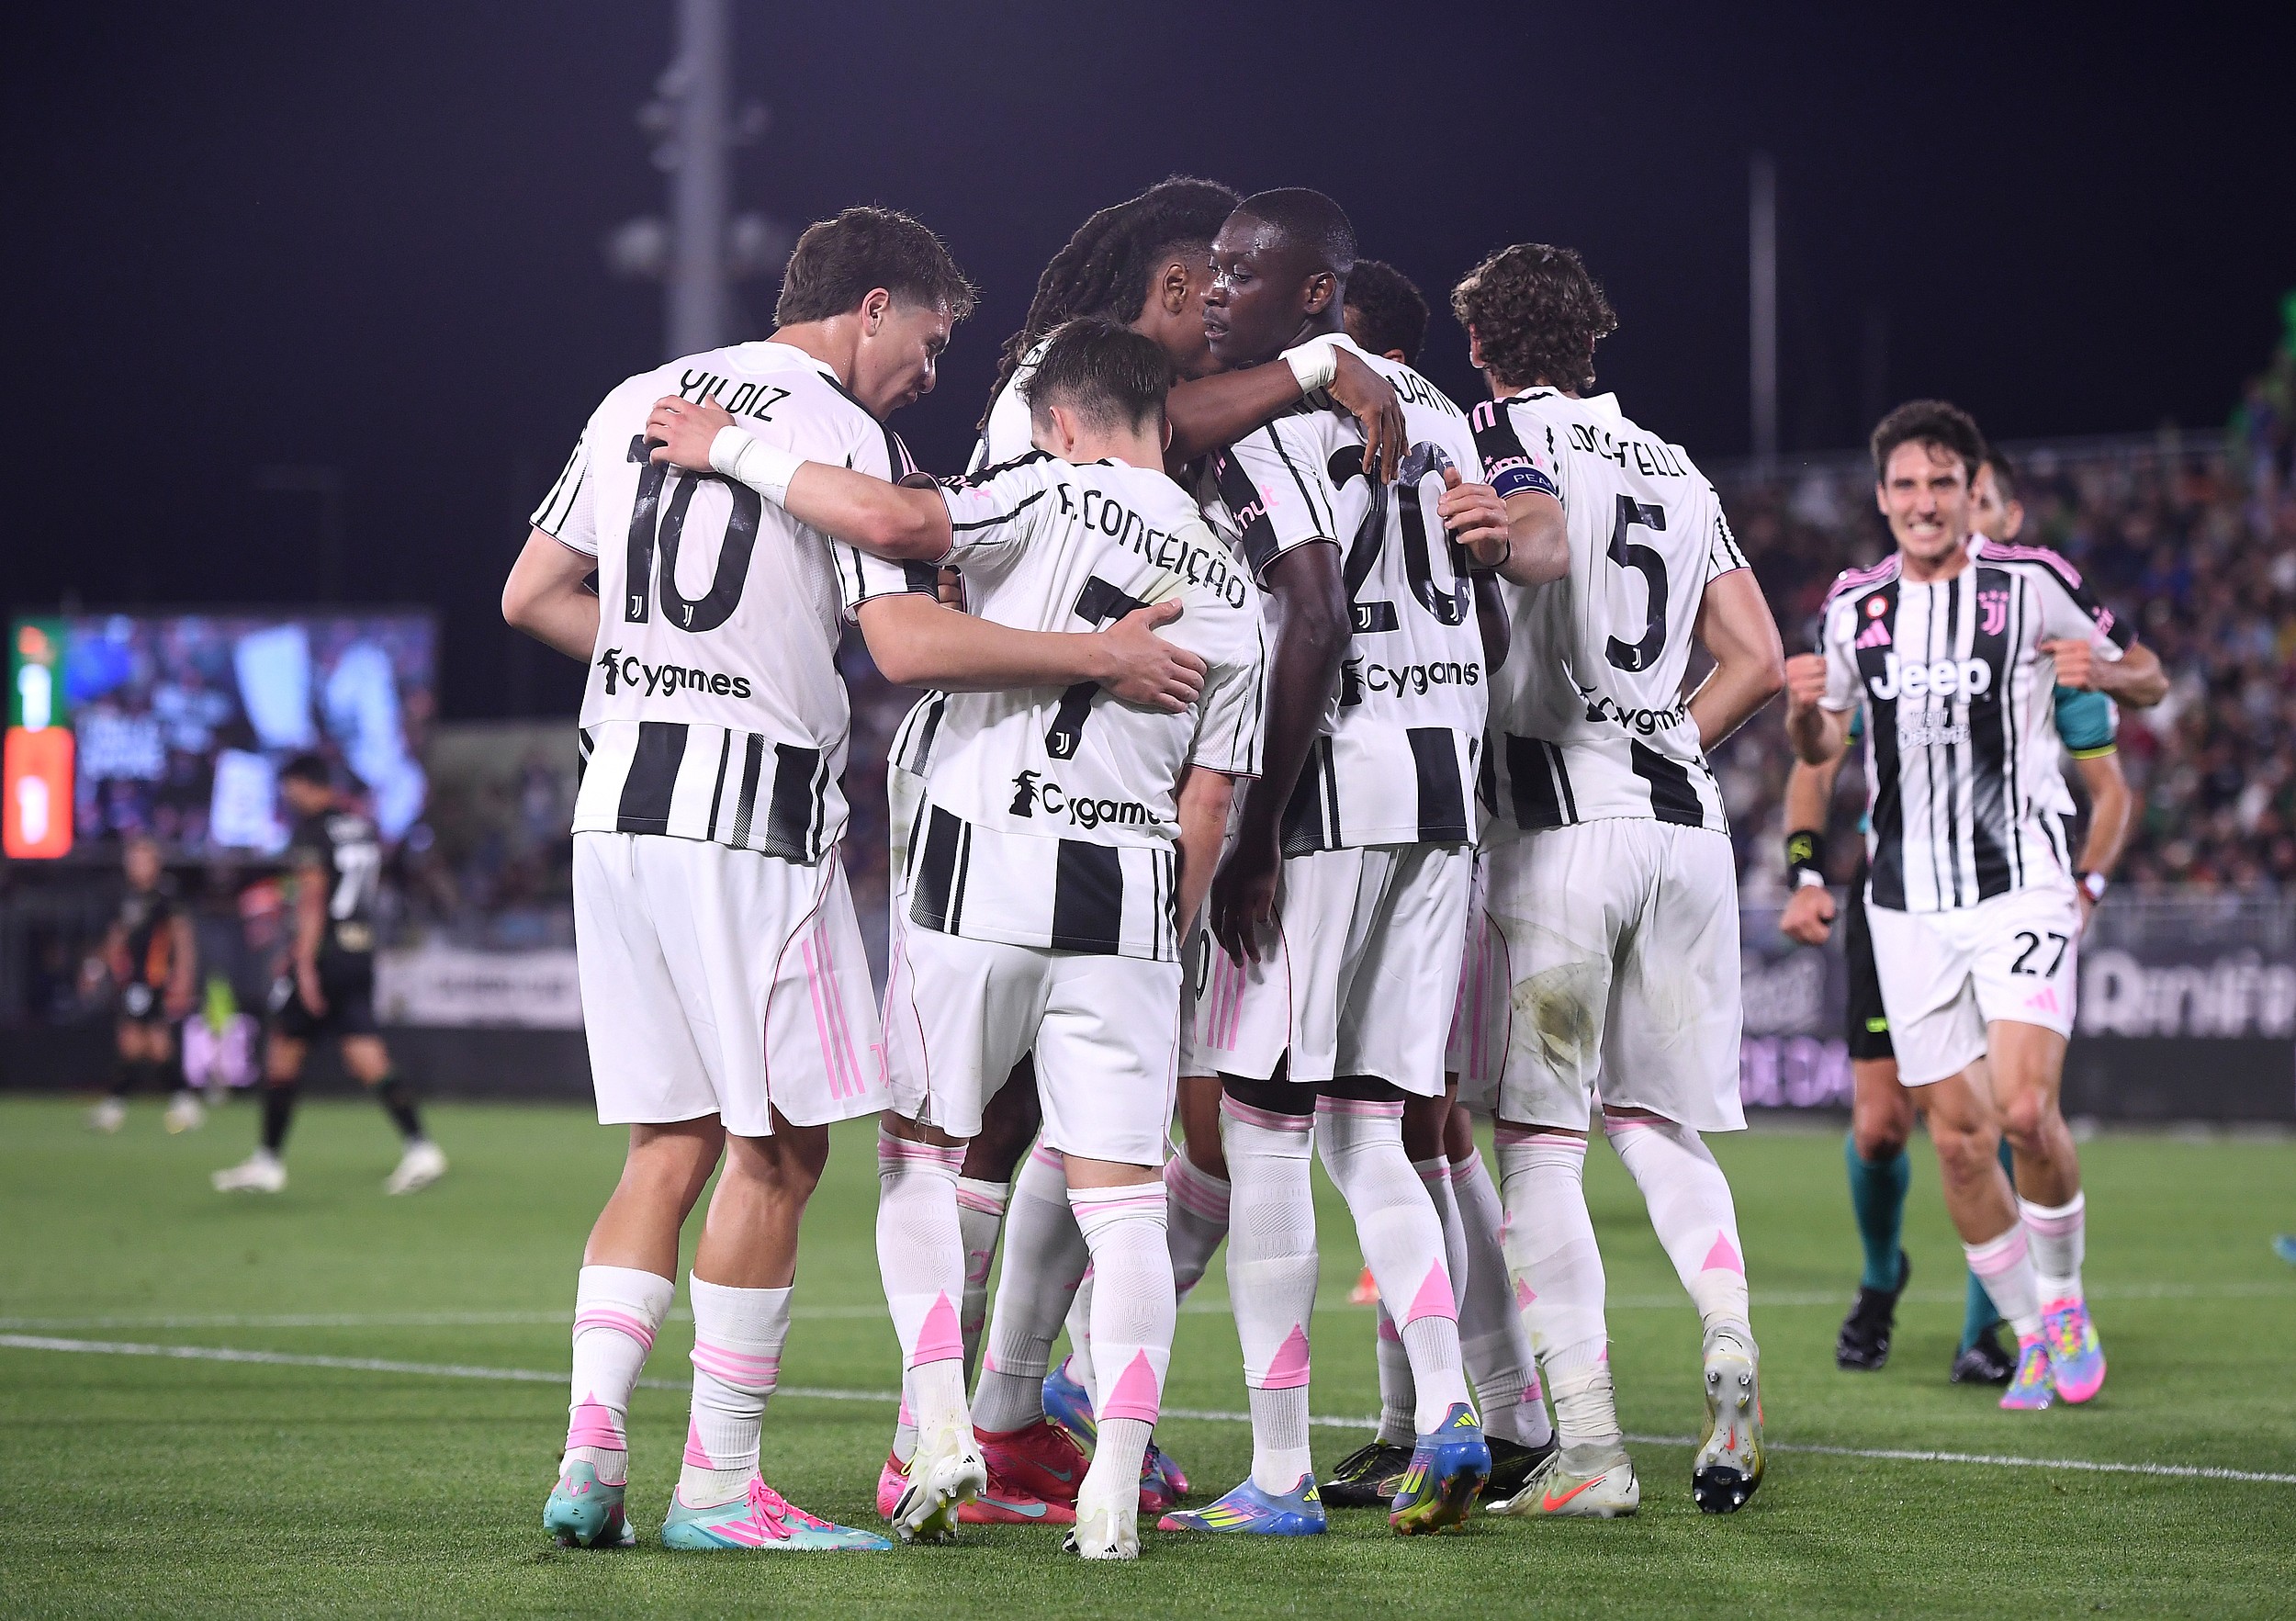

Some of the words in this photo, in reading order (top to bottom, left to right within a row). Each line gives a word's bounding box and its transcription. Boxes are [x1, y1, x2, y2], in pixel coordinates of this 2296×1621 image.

[1566, 423, 1688, 477] LOCTELLI
[625, 434, 762, 633] 10
[1327, 442, 1471, 634] 20
[1605, 493, 1669, 674] 5
[1870, 651, 1992, 704] Jeep
[2010, 931, 2069, 978] 27
